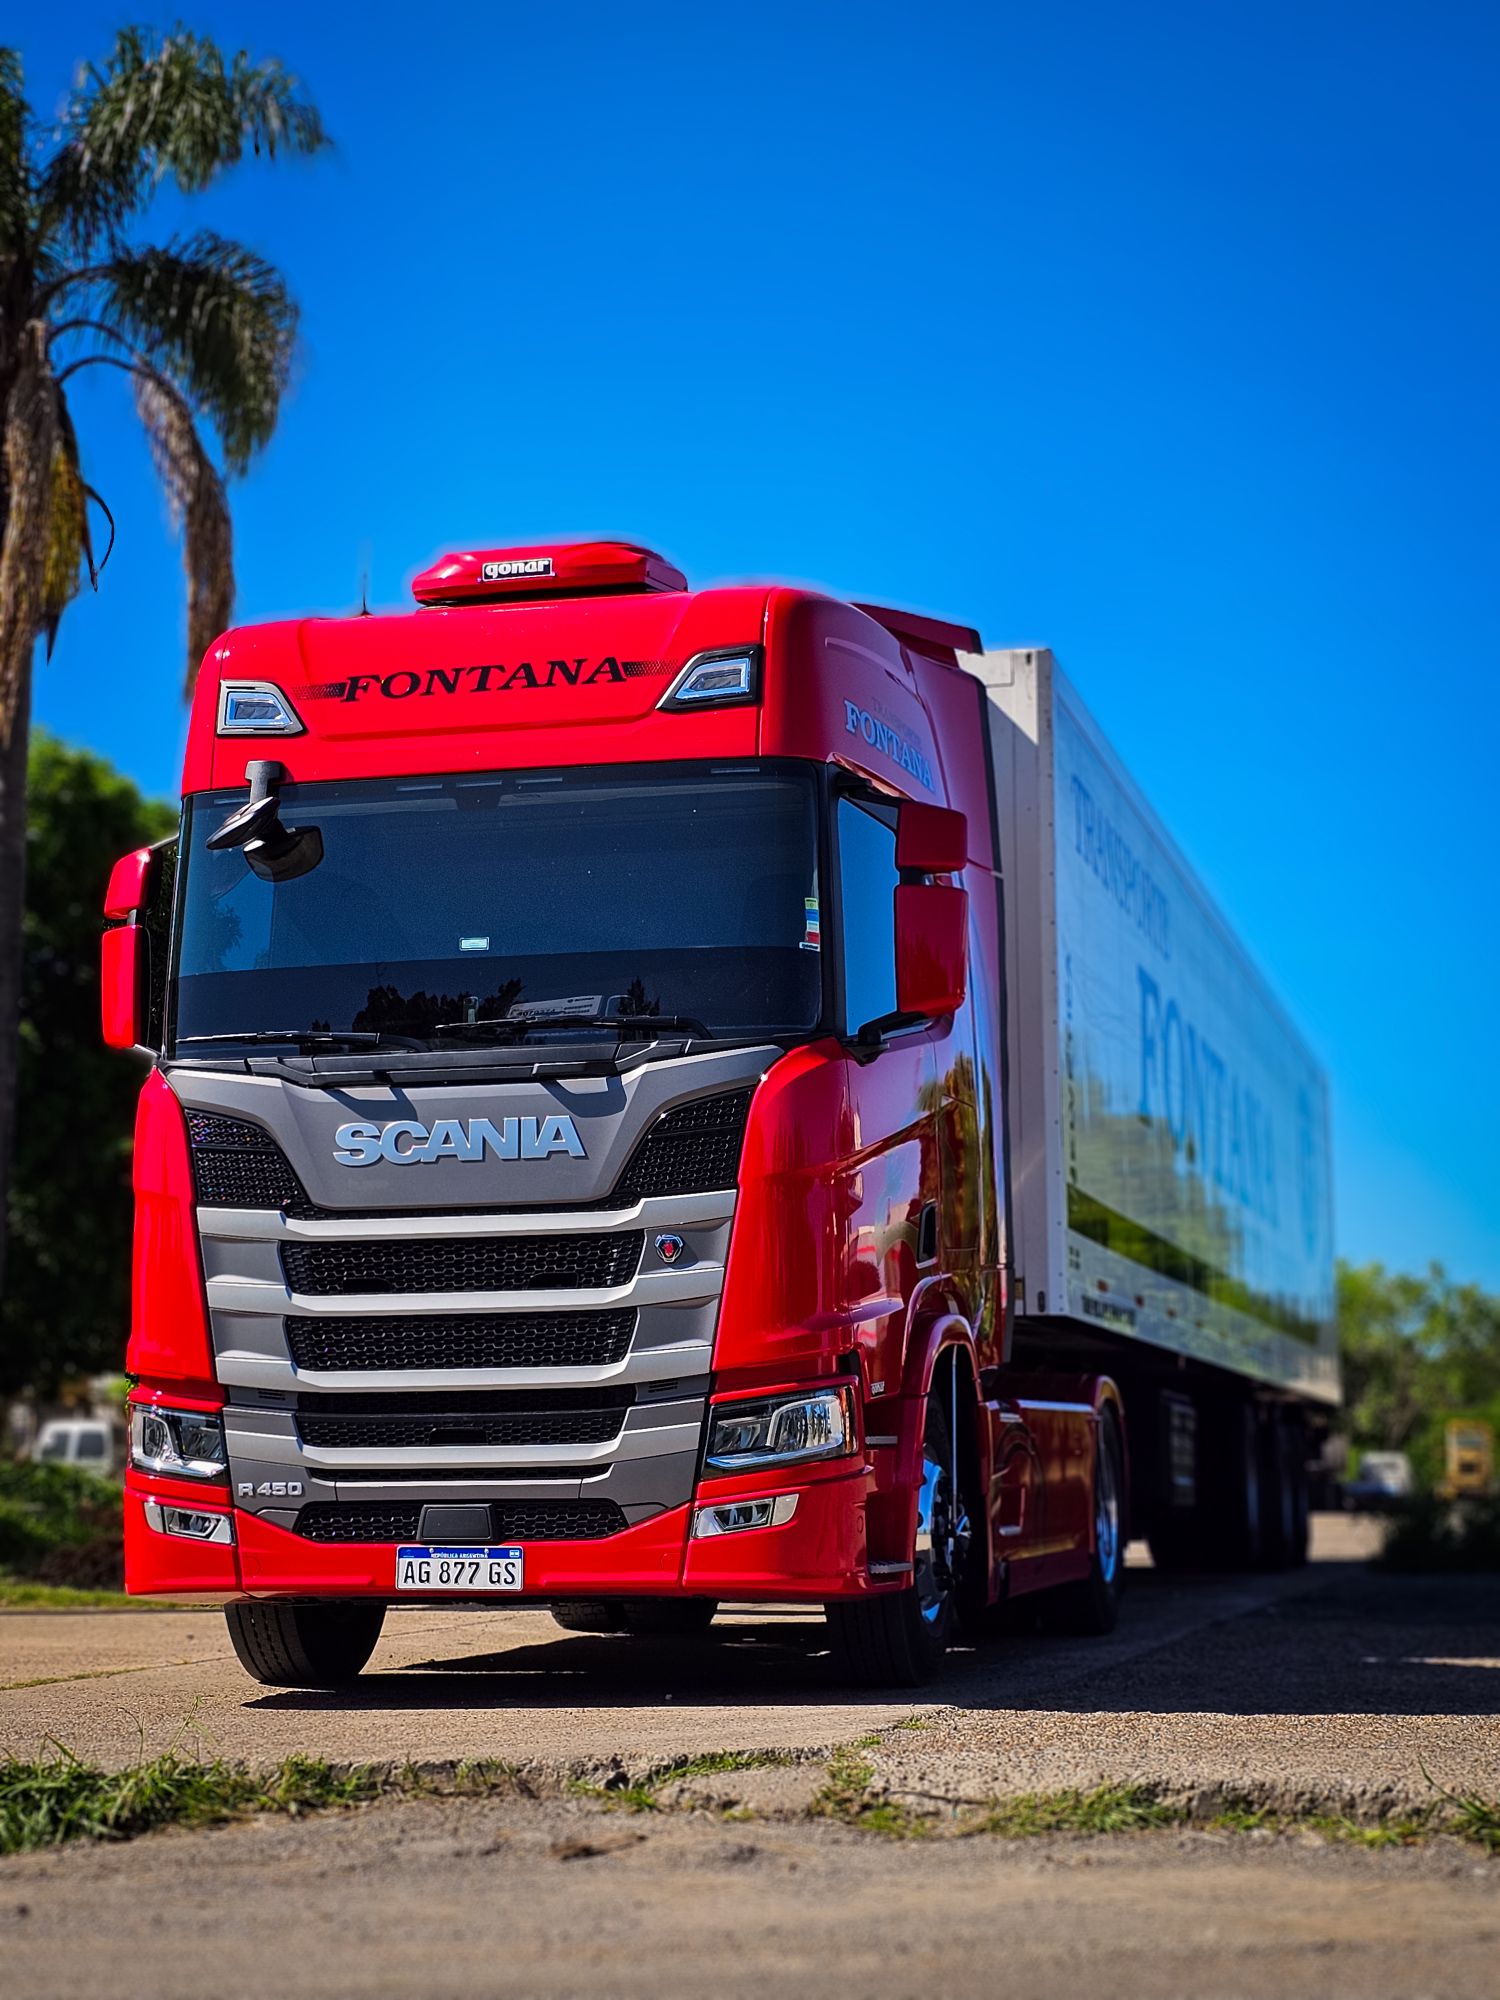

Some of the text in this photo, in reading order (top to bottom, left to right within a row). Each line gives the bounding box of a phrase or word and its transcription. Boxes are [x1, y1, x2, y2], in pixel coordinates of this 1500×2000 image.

[485, 560, 550, 579] gonar
[340, 656, 627, 703] FONTANA
[843, 697, 936, 795] FONTANA
[333, 1115, 586, 1168] SCANIA
[238, 1481, 303, 1496] R 450
[403, 1561, 516, 1585] AG 877 GS
